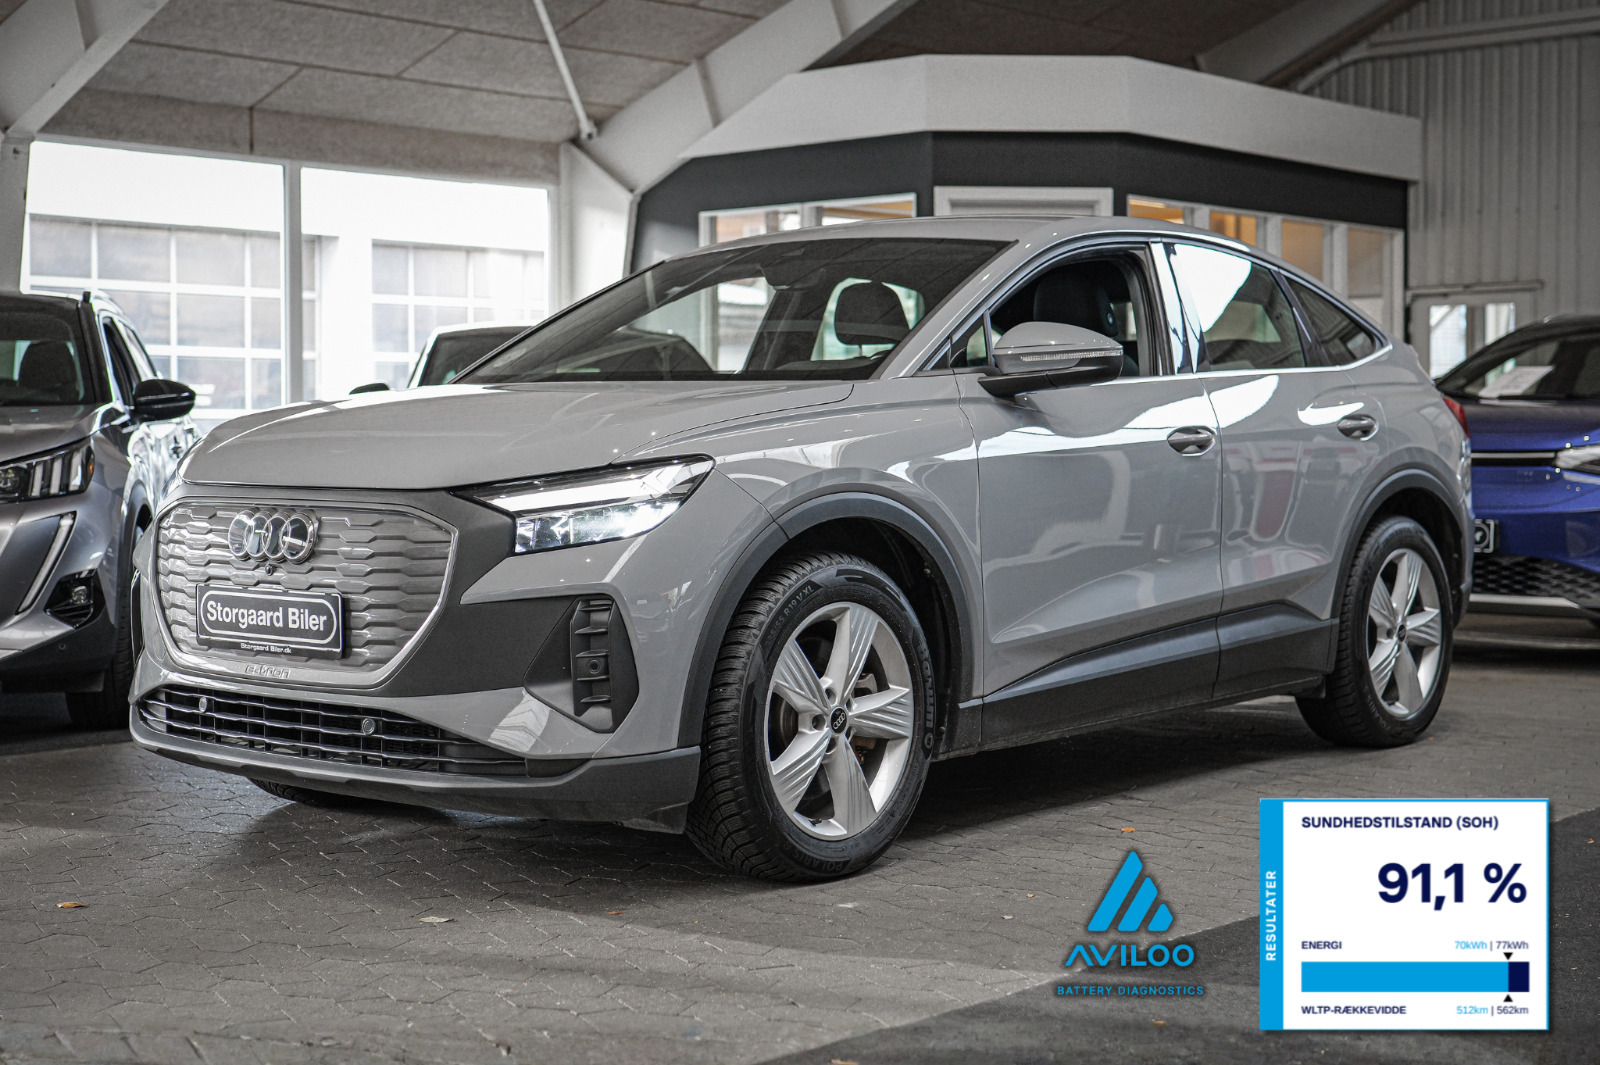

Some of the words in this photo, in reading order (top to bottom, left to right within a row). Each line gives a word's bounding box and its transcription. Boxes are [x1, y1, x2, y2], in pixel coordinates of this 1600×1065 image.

[802, 585, 815, 597] XL
[206, 600, 283, 629] Storgaard
[288, 607, 327, 631] Biler
[240, 642, 269, 652] Storgaard
